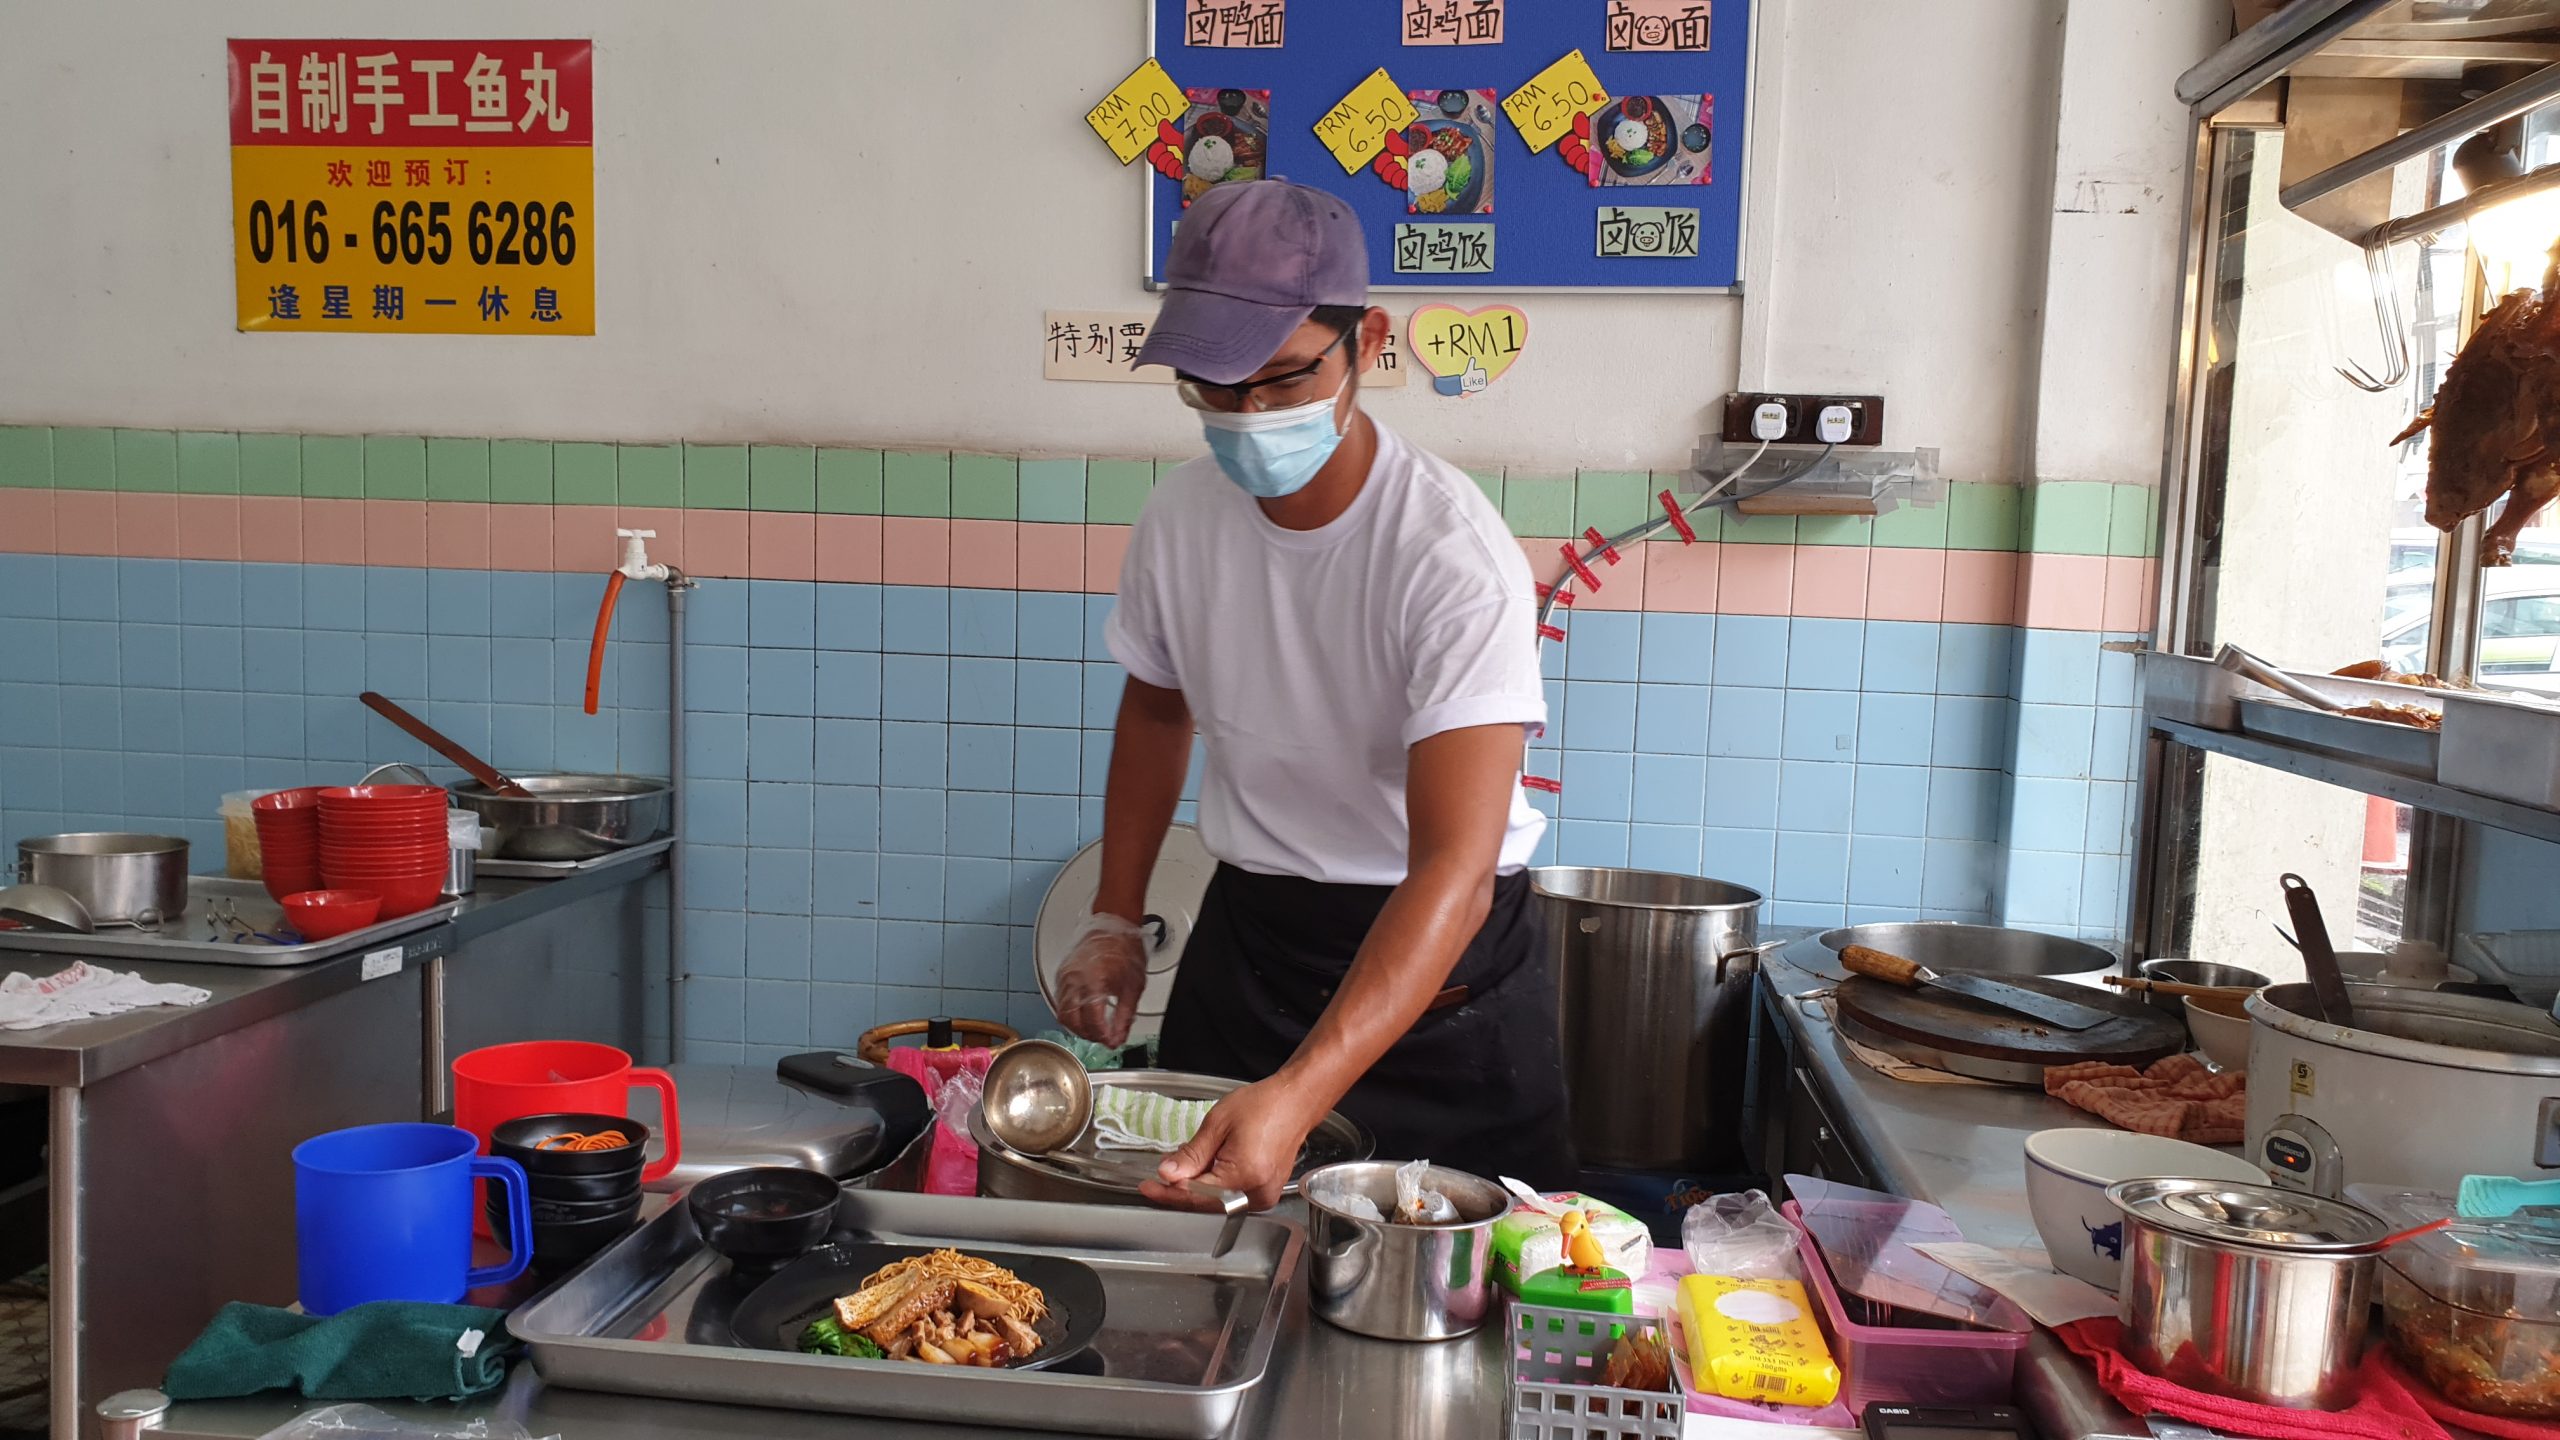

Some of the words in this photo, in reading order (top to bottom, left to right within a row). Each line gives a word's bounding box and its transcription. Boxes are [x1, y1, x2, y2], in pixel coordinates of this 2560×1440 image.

[1187, 0, 1284, 46] 卤鸭面
[1406, 0, 1500, 45] 卤鸡面
[249, 50, 570, 134] 自制手工鱼丸
[1096, 93, 1131, 127] RM
[1510, 83, 1546, 113] RM
[1532, 81, 1589, 132] 6.50
[1116, 92, 1171, 146] 7.00
[1322, 102, 1360, 135] RM
[1349, 97, 1402, 153] 6.50
[249, 199, 330, 264] 016
[372, 200, 452, 266] 665
[467, 200, 577, 266] 6286
[1397, 225, 1492, 271] 卤鸡饭
[267, 284, 562, 322] 逢星期一休息
[1462, 376, 1485, 388] Like
[2273, 1141, 2306, 1159] National
[1878, 1407, 1910, 1415] CASIO
